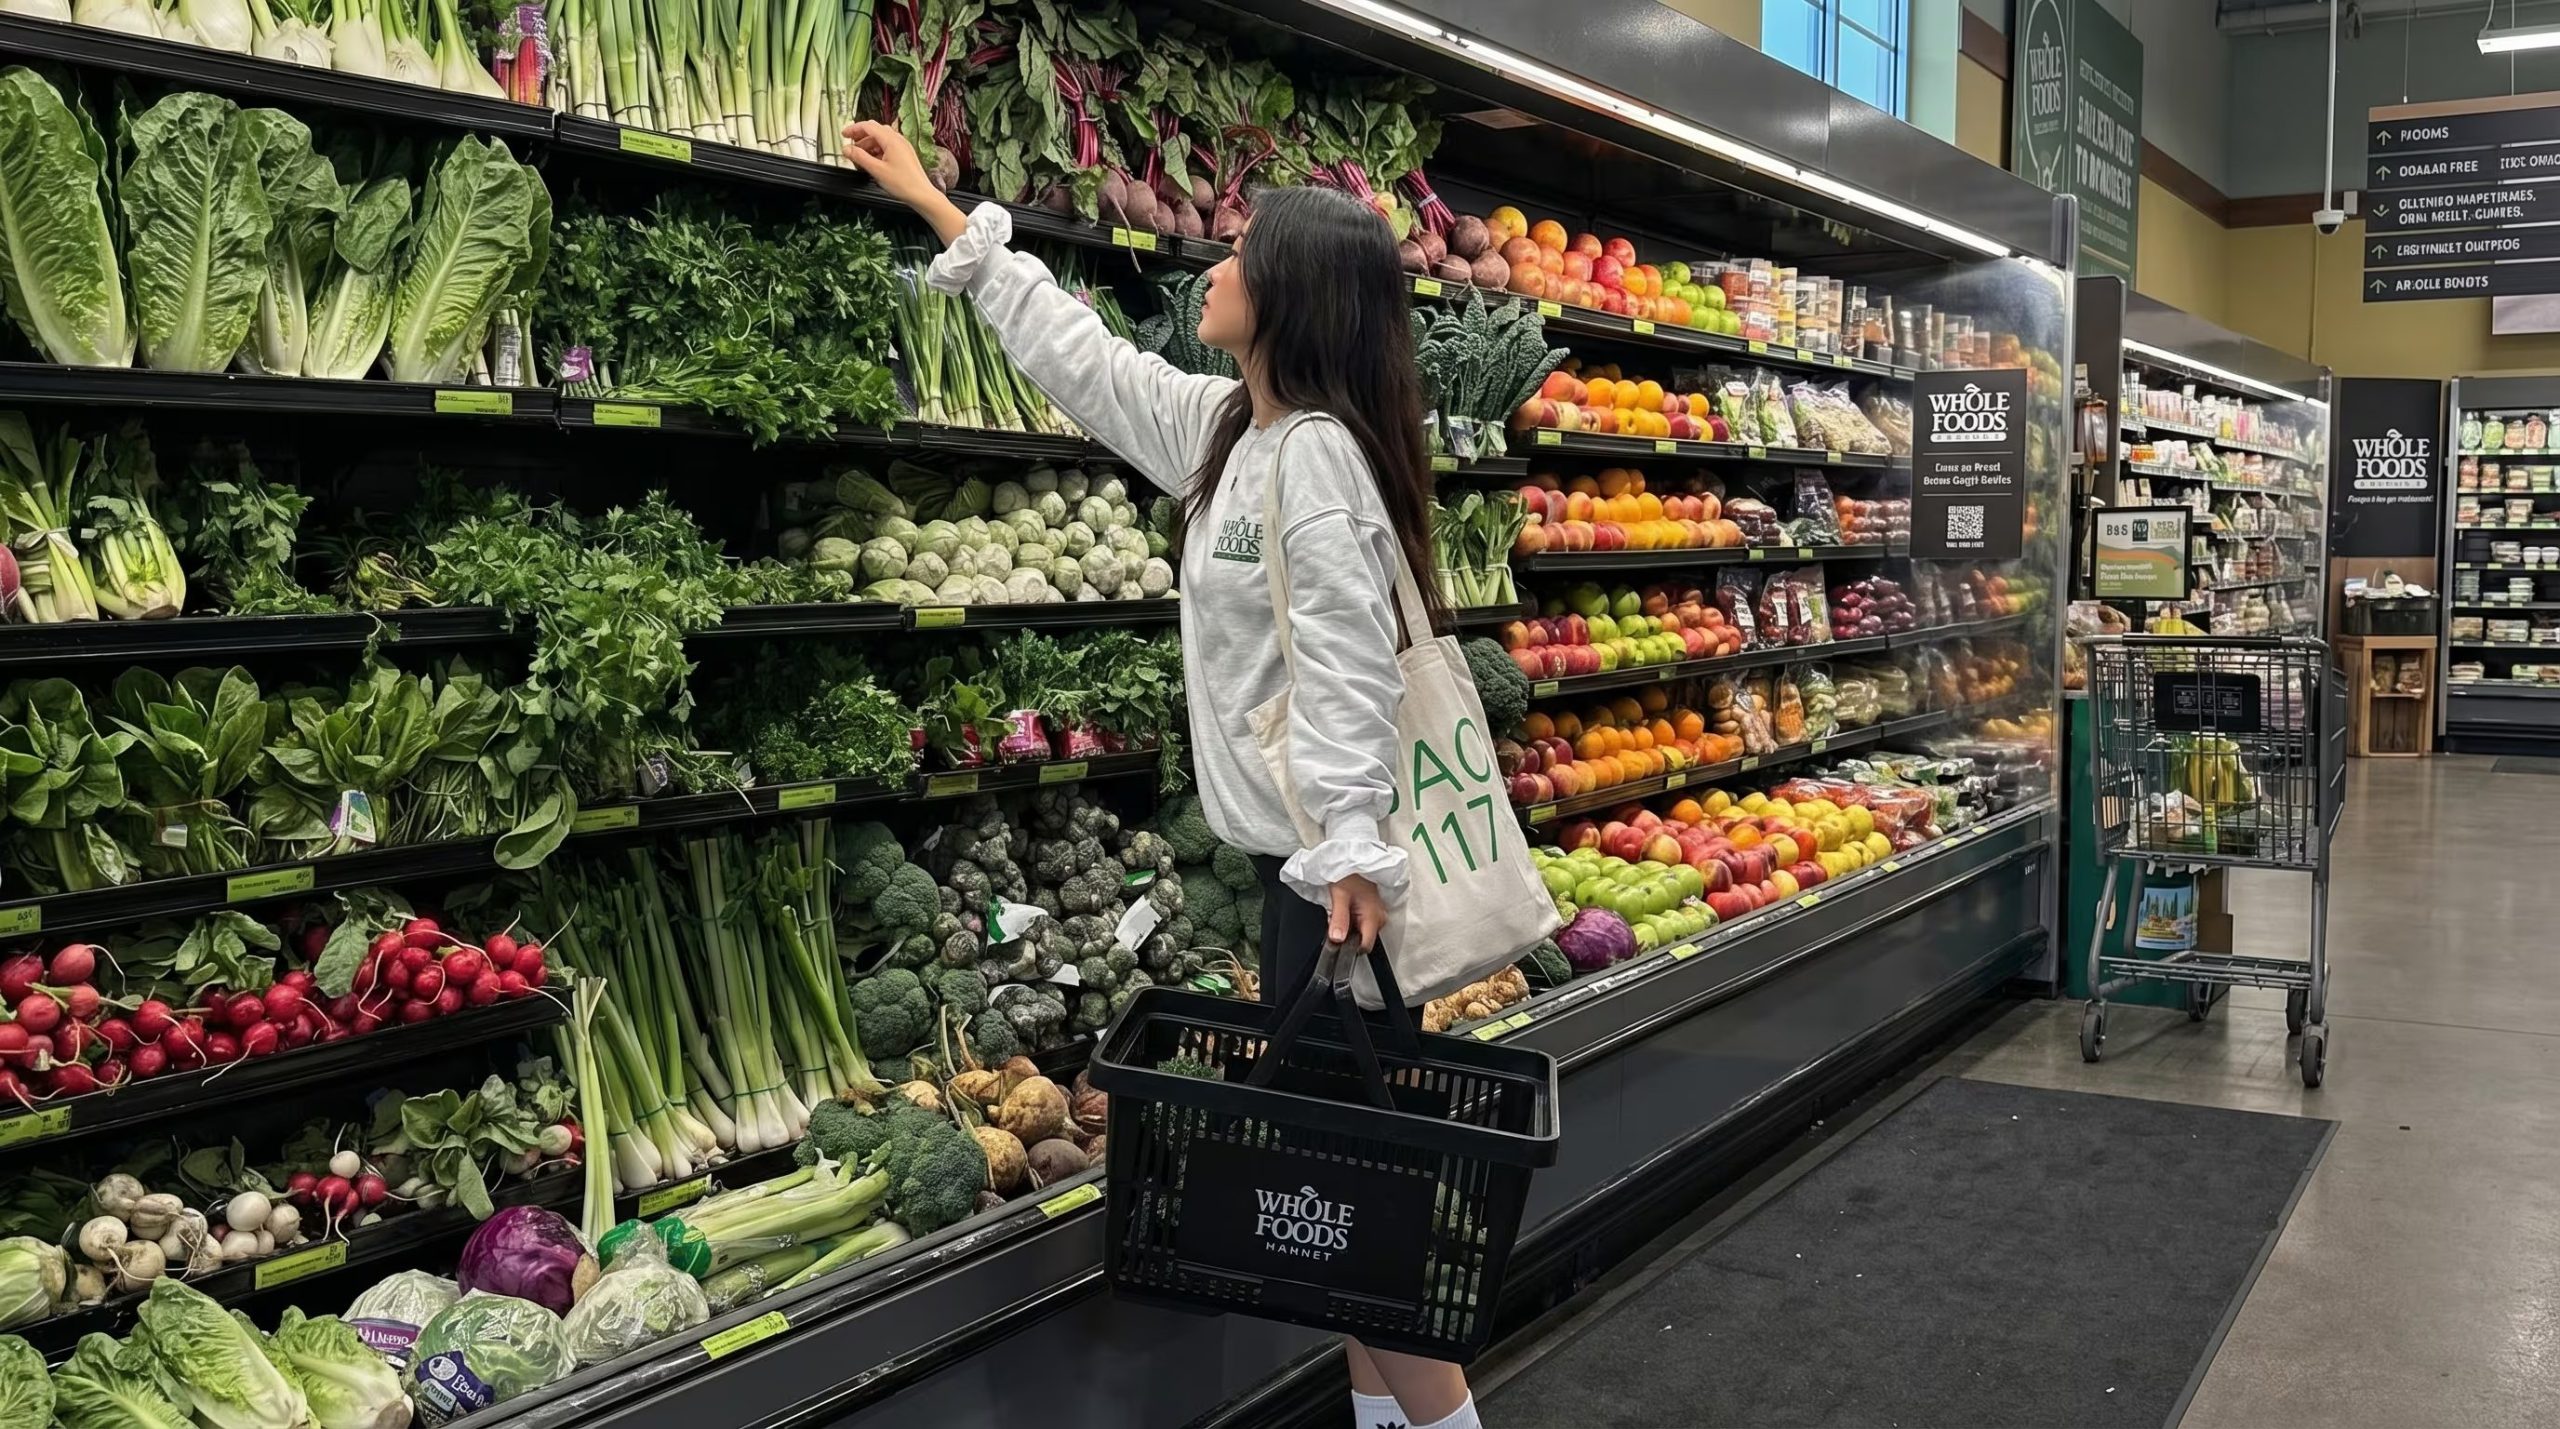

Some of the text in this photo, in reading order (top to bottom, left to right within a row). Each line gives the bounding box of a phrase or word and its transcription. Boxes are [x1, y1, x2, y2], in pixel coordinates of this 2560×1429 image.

[2029, 44, 2062, 82] WHOLE
[2031, 81, 2062, 117] FOODS
[2450, 160, 2479, 173] FREE
[1928, 390, 2010, 413] WHOLE
[2352, 436, 2430, 458] WHOLE
[1411, 793, 1498, 885] 117
[1254, 1187, 1355, 1227] WHOLE
[1254, 1213, 1349, 1250] FOODS
